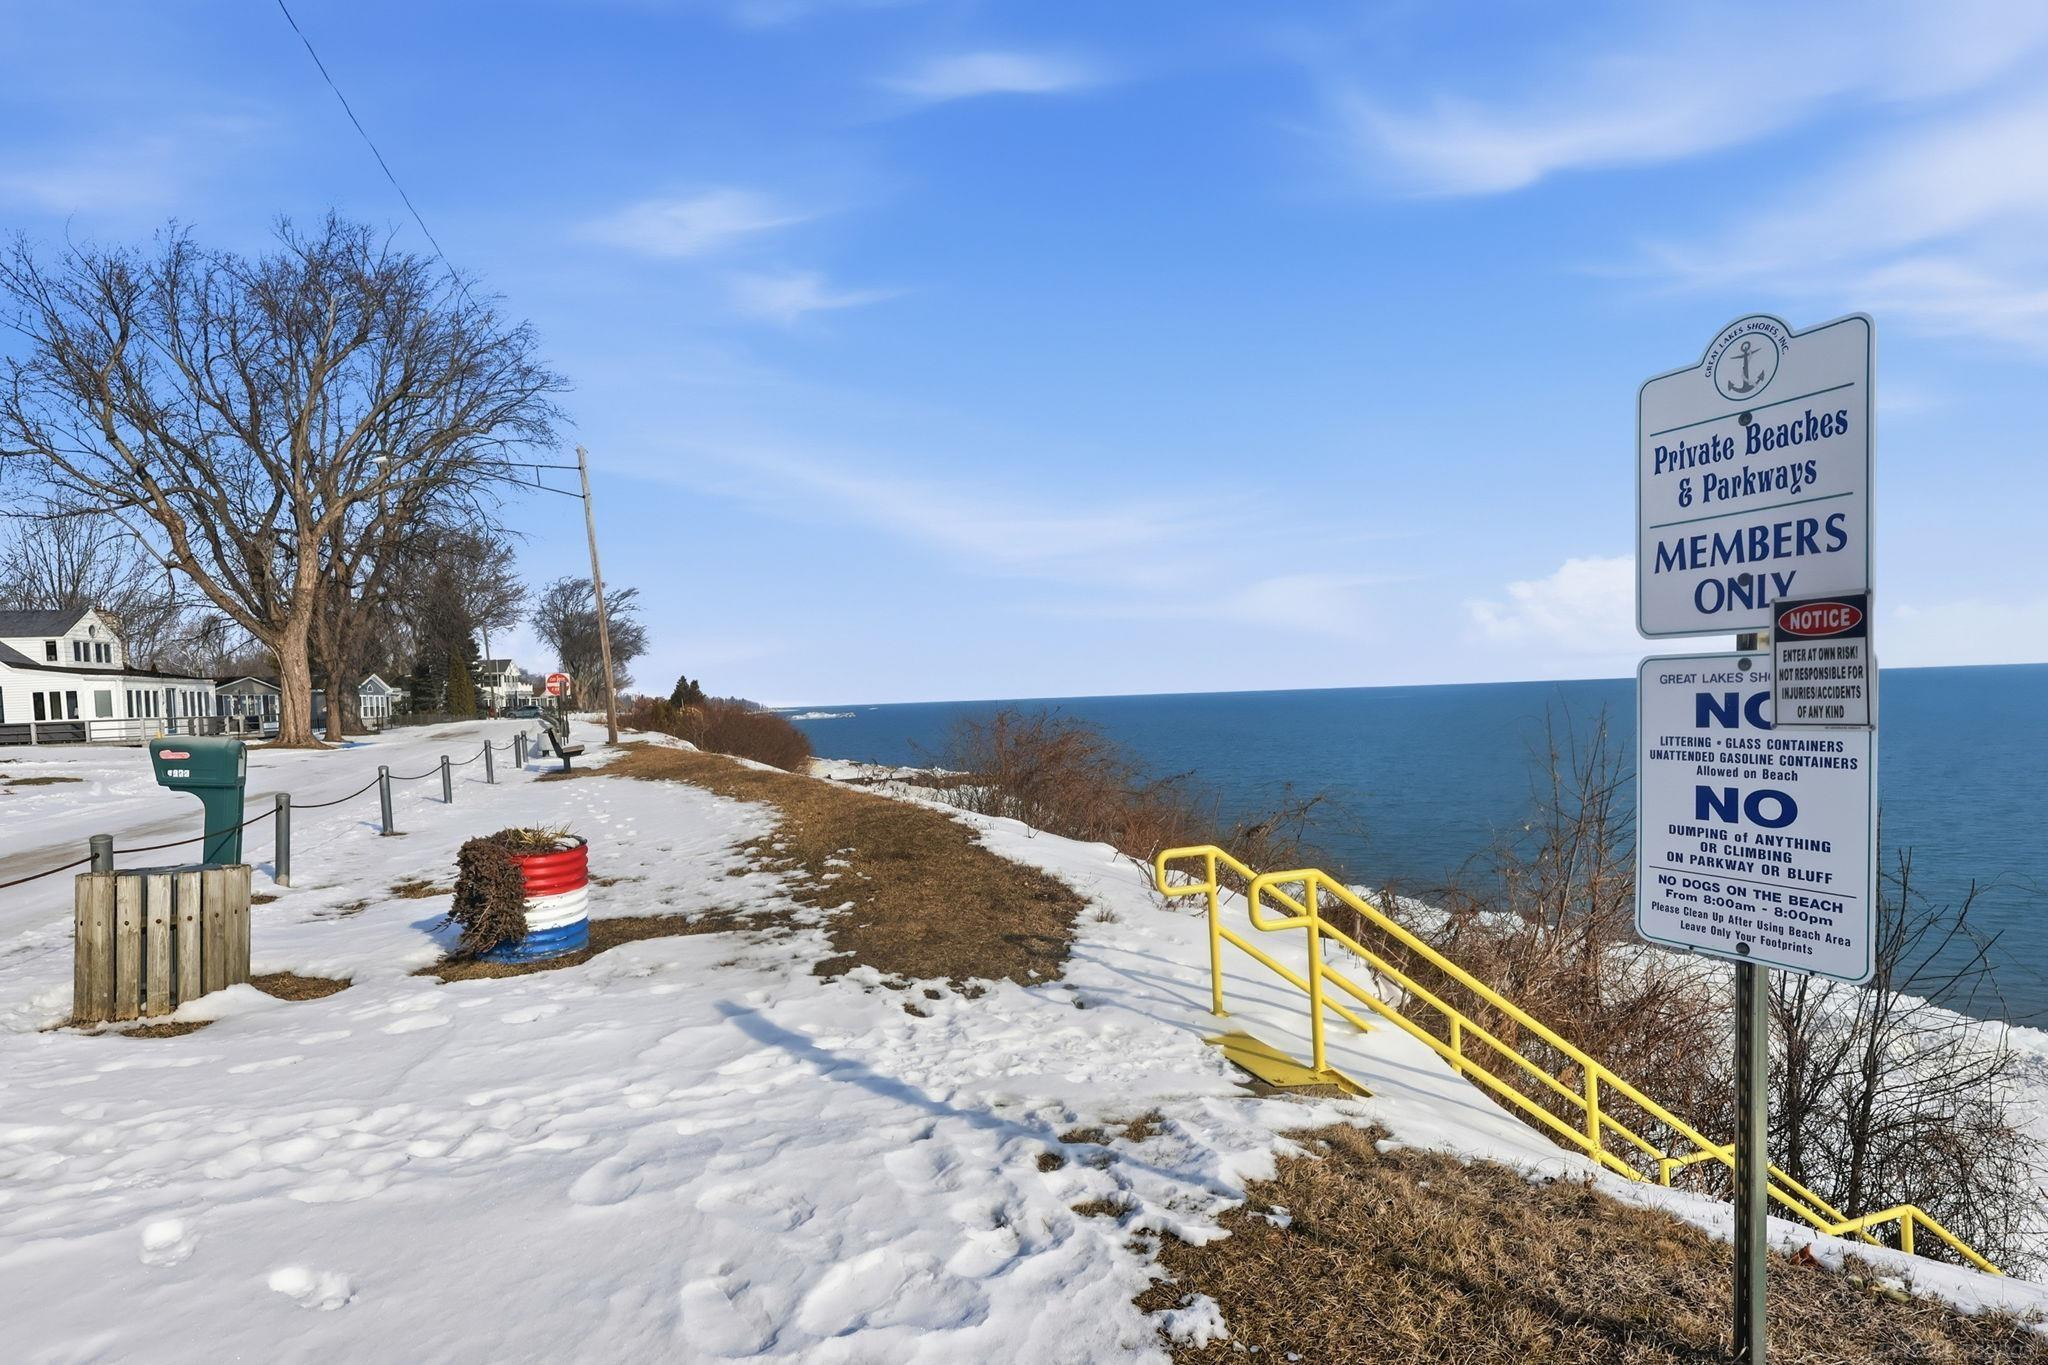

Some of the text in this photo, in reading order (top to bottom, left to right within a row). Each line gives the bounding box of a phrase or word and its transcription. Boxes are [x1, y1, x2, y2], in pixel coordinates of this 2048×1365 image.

[1704, 350, 1719, 378] GREAT
[1719, 327, 1744, 348] LAKES
[1654, 409, 1848, 475] Private Beaches
[1678, 459, 1817, 508] & Parkways
[1654, 512, 1848, 575] MEMBERS
[1694, 570, 1797, 614] ONLY
[1790, 608, 1850, 630] NOTICE
[1782, 646, 1858, 662] ENTER AT OWN RISK!
[1660, 673, 1697, 684] GREAT
[1702, 672, 1744, 684] LAKES
[1779, 665, 1864, 681] NOT RESPONSIBLE FOR
[1782, 685, 1861, 700] INJURIES/ACCIDENTS
[1797, 705, 1844, 718] OF ANY KIND
[1649, 750, 1858, 770] UNATTENDED GASOLINE CONTAINERS
[1660, 736, 1844, 753] LITTERING GLASS CONTAINERS
[1696, 766, 1798, 782] Allowed on Beach
[1695, 785, 1798, 828] NO
[1668, 824, 1832, 853] DUMPING of ANYTHING
[1700, 842, 1793, 864] OR CLIMBING
[1666, 851, 1833, 884] ON PARKWAY OR BLUFF
[1658, 874, 1844, 914] NO DOGS ON THE BEACH
[1665, 888, 1698, 902] From
[1704, 894, 1756, 913] 8:00am
[1774, 907, 1834, 927] 8:00pm
[1651, 901, 1852, 948] Please Clean Up After Using Beach Area
[1680, 920, 1813, 956] Leave Only Your Footprints
